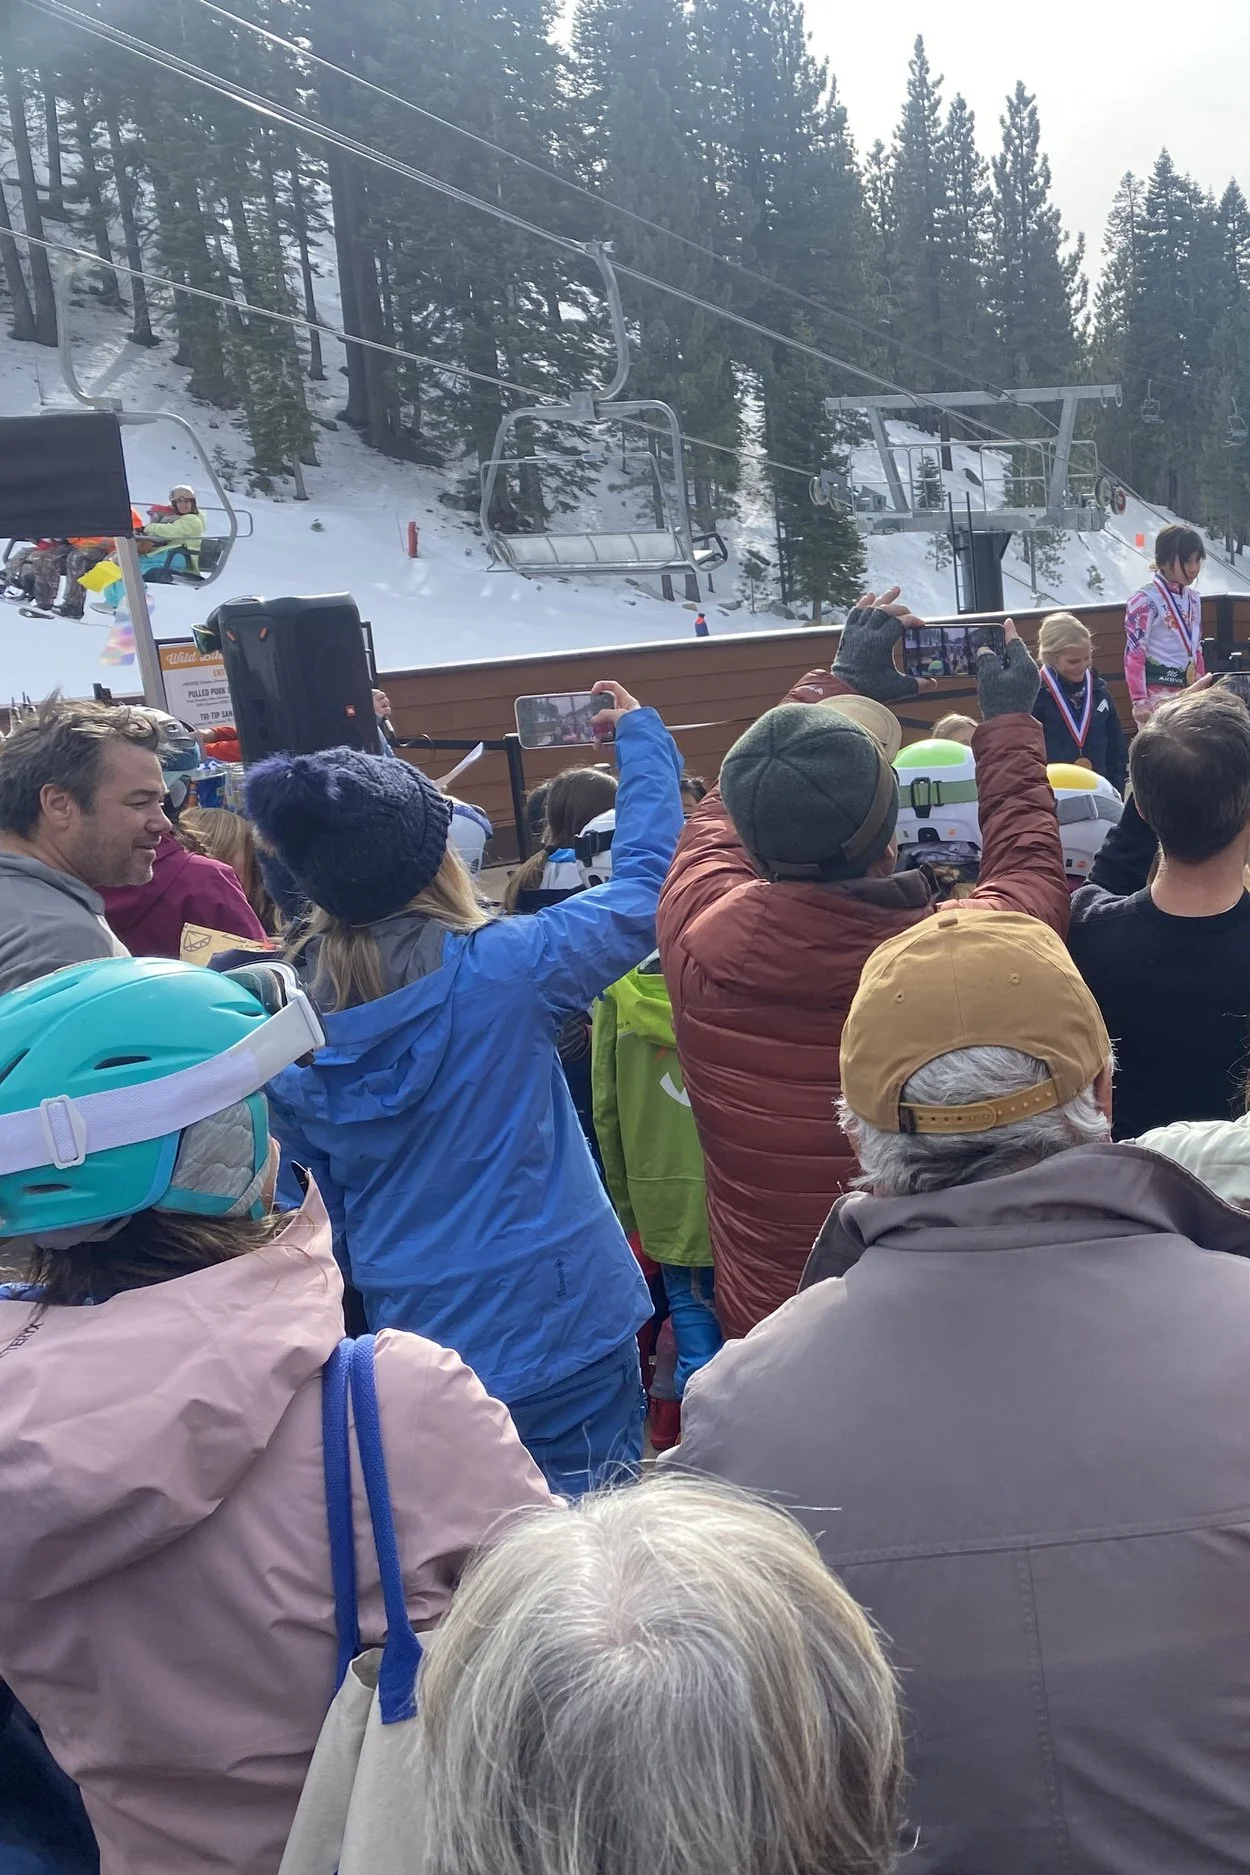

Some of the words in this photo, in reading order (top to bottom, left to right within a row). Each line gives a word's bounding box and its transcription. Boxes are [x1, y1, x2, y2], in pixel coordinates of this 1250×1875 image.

[188, 689, 209, 698] PULLED
[211, 687, 226, 695] PORK
[200, 711, 220, 720] TRI-TIP
